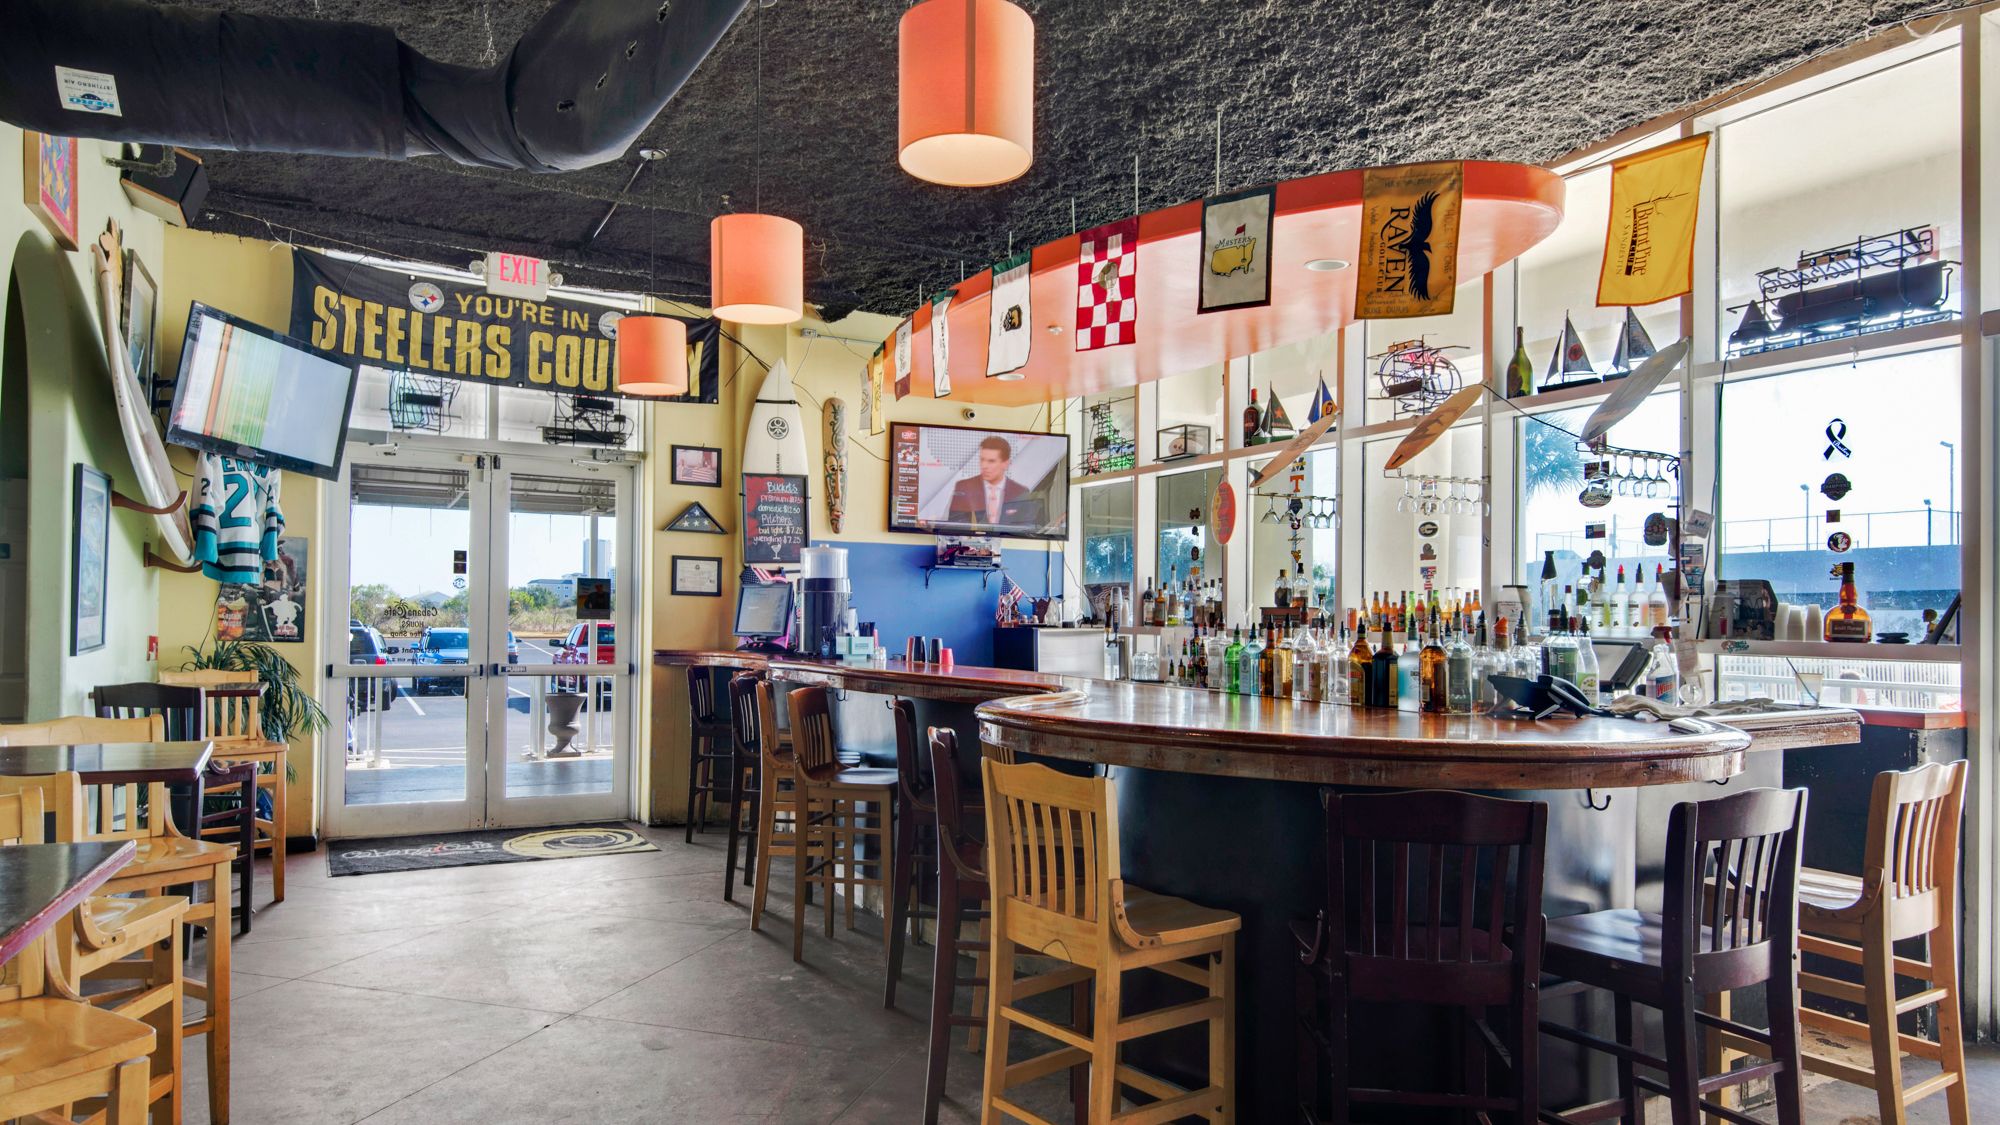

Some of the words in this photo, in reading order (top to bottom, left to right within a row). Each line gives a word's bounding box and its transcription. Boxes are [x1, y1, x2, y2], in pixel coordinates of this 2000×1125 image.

[1637, 207, 1654, 246] Burnt
[1378, 242, 1386, 267] GOLF
[1380, 206, 1411, 294] RAVEN
[1631, 246, 1652, 276] Pine
[499, 253, 540, 286] EXIT
[1376, 268, 1385, 293] CLUB
[455, 292, 555, 327] YOU'RE
[563, 310, 589, 332] IN
[311, 285, 511, 379] STEELERS
[528, 330, 704, 397] COUY
[1290, 474, 1304, 493] T
[761, 513, 792, 524] Pitchers
